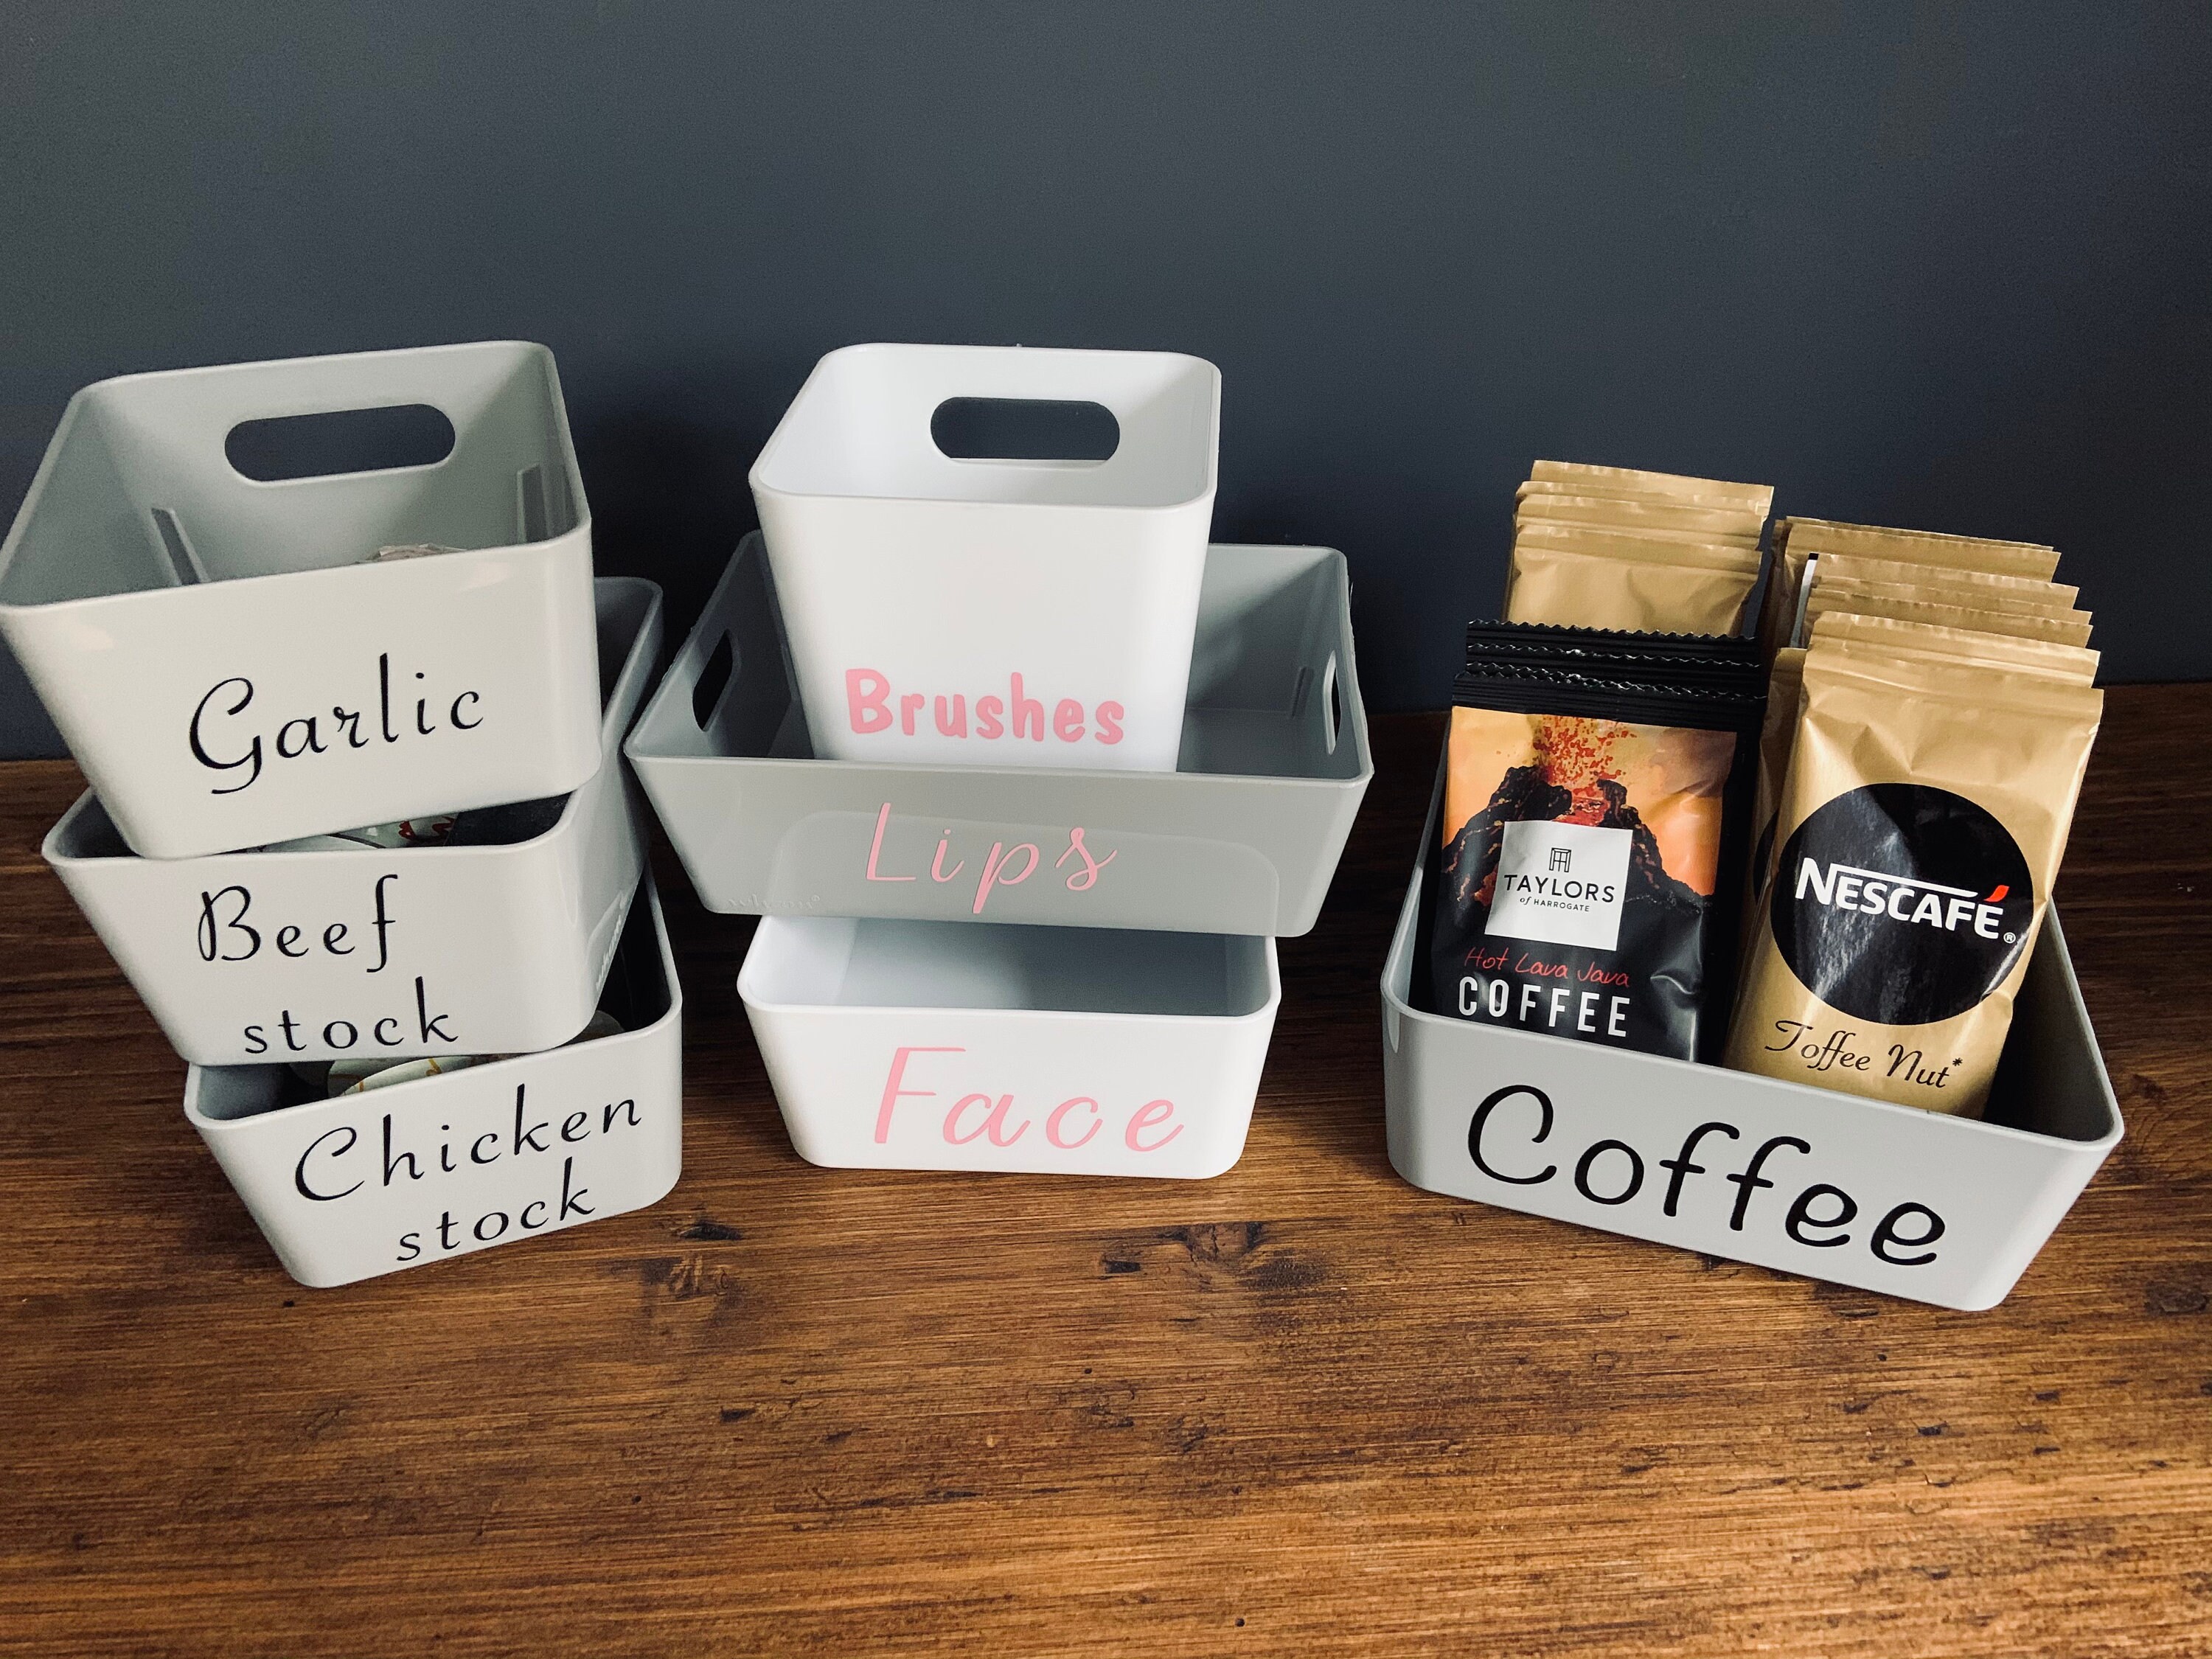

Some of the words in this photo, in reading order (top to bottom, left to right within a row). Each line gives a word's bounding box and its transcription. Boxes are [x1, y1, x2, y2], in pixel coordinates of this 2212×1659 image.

[189, 653, 484, 794] Garlic
[845, 668, 1124, 745] Brushes
[866, 803, 1116, 914] Lips
[1503, 874, 1615, 903] TAYLORS
[1795, 857, 2011, 940] NESCAFÉ
[198, 874, 397, 973] Beef
[1520, 897, 1531, 905] of
[1534, 900, 1590, 912] HARROGATE
[1459, 976, 1630, 1037] COFFEE
[1464, 947, 1509, 970] Hot
[1515, 953, 1568, 979] Lava
[1577, 961, 1630, 987] Java
[245, 976, 458, 1054] stock
[1764, 1020, 1871, 1071] Toffee
[874, 1046, 1183, 1152] Face
[296, 1084, 641, 1200] Chicken
[1468, 1085, 1945, 1265] Coffee
[397, 1157, 595, 1261] stock
